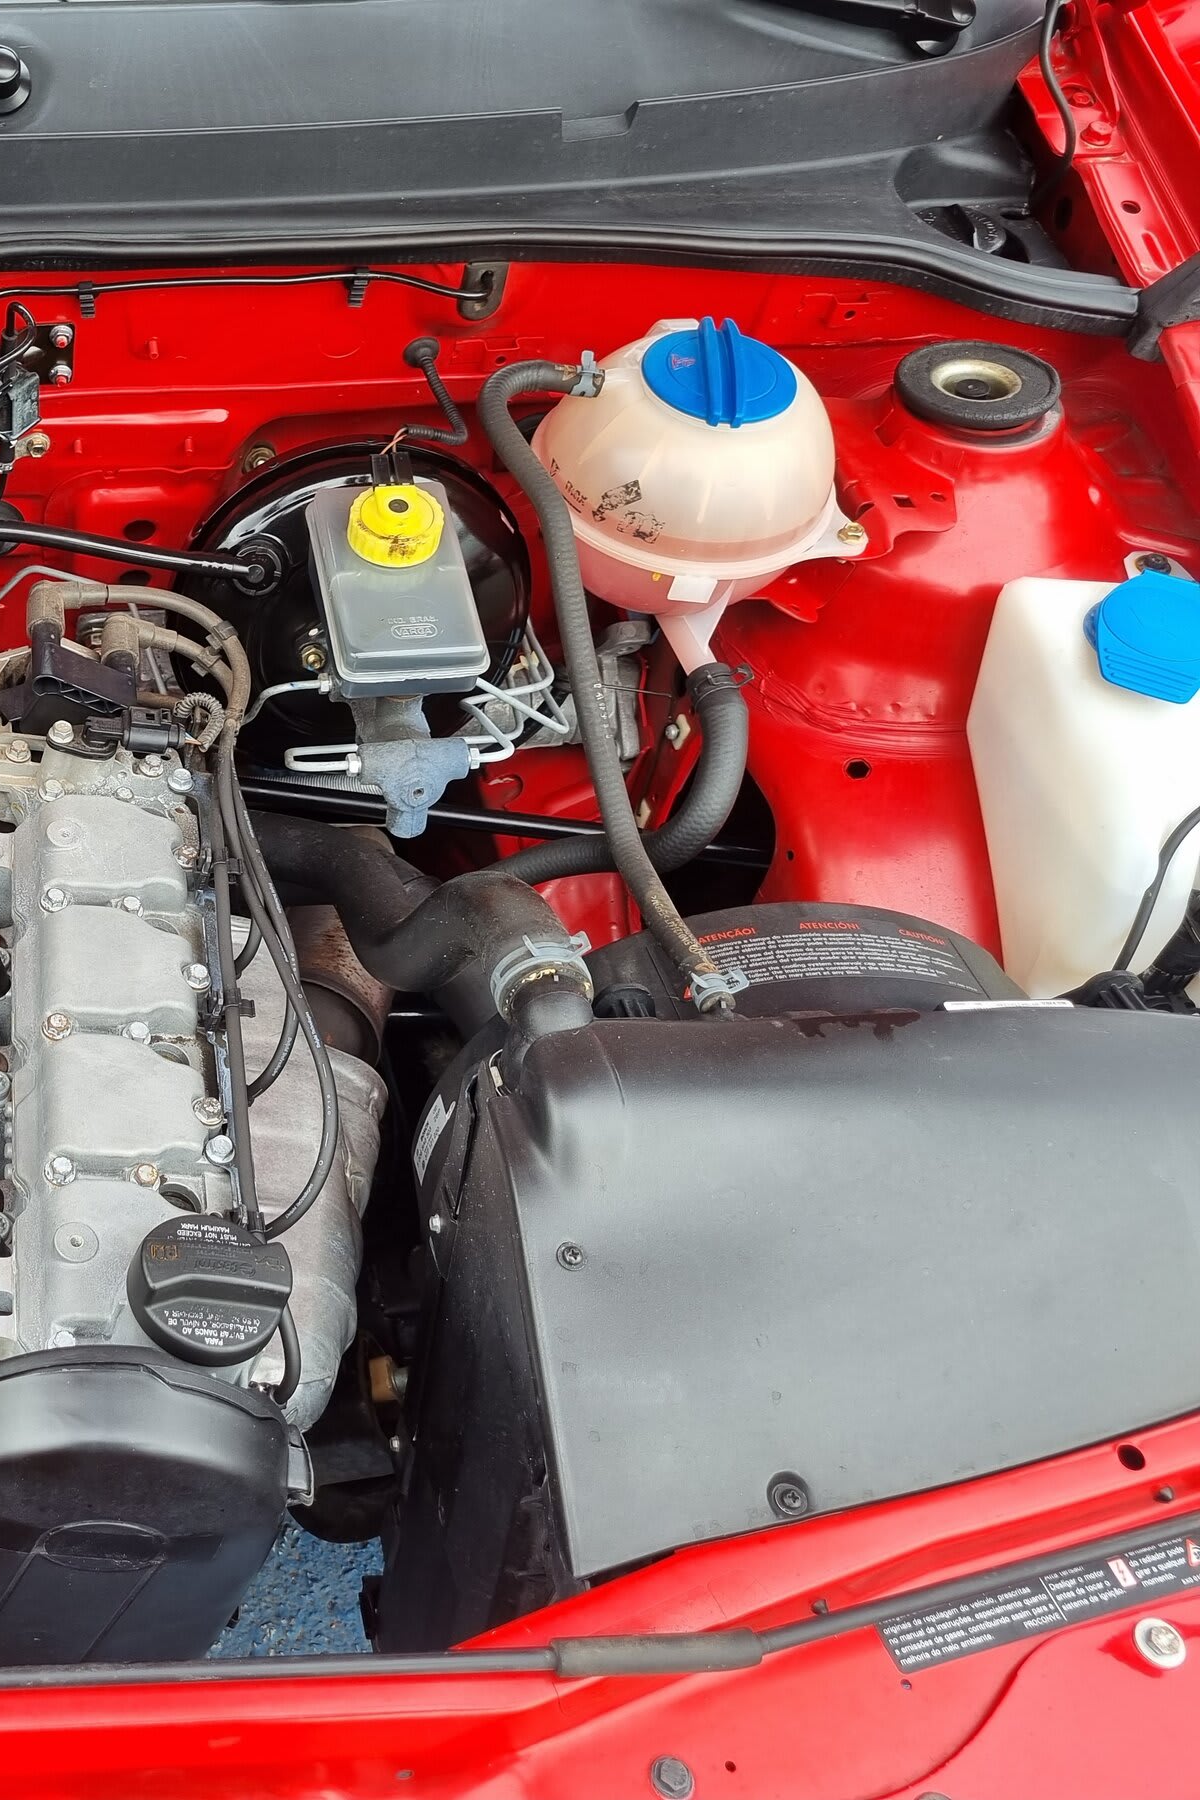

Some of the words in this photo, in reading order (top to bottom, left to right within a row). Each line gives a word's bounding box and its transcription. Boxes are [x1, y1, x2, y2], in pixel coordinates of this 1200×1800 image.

[176, 1230, 202, 1238] EXCEED
[200, 1224, 230, 1233] MAXIMUM
[168, 1318, 178, 1326] DE
[182, 1327, 195, 1335] AO
[205, 1337, 224, 1346] PARA
[1138, 1552, 1167, 1564] radiador
[1158, 1557, 1186, 1572] qualquer
[1048, 1578, 1076, 1592] Desligar
[1084, 1570, 1104, 1582] motor
[1141, 1572, 1177, 1588] momento.
[1056, 1590, 1076, 1602] antes
[1084, 1582, 1104, 1594] tocar
[882, 1620, 912, 1635] originais
[912, 1618, 922, 1626] de
[922, 1606, 960, 1623] regulagem
[960, 1603, 970, 1612] do
[996, 1586, 1032, 1602] prescritas
[1062, 1598, 1090, 1612] sistema
[888, 1636, 899, 1646] no
[899, 1628, 926, 1642] manual
[926, 1626, 936, 1635] de
[974, 1600, 1023, 1620] especialmente
[1022, 1592, 1049, 1606] quanto
[934, 1634, 944, 1644] de
[968, 1615, 1012, 1634] contribuindo
[1010, 1610, 1032, 1622] assim
[1031, 1604, 1049, 1616] para
[900, 1650, 931, 1666] melhoria
[930, 1648, 941, 1658] do
[941, 1642, 960, 1654] meio
[960, 1633, 996, 1648] ambiente.
